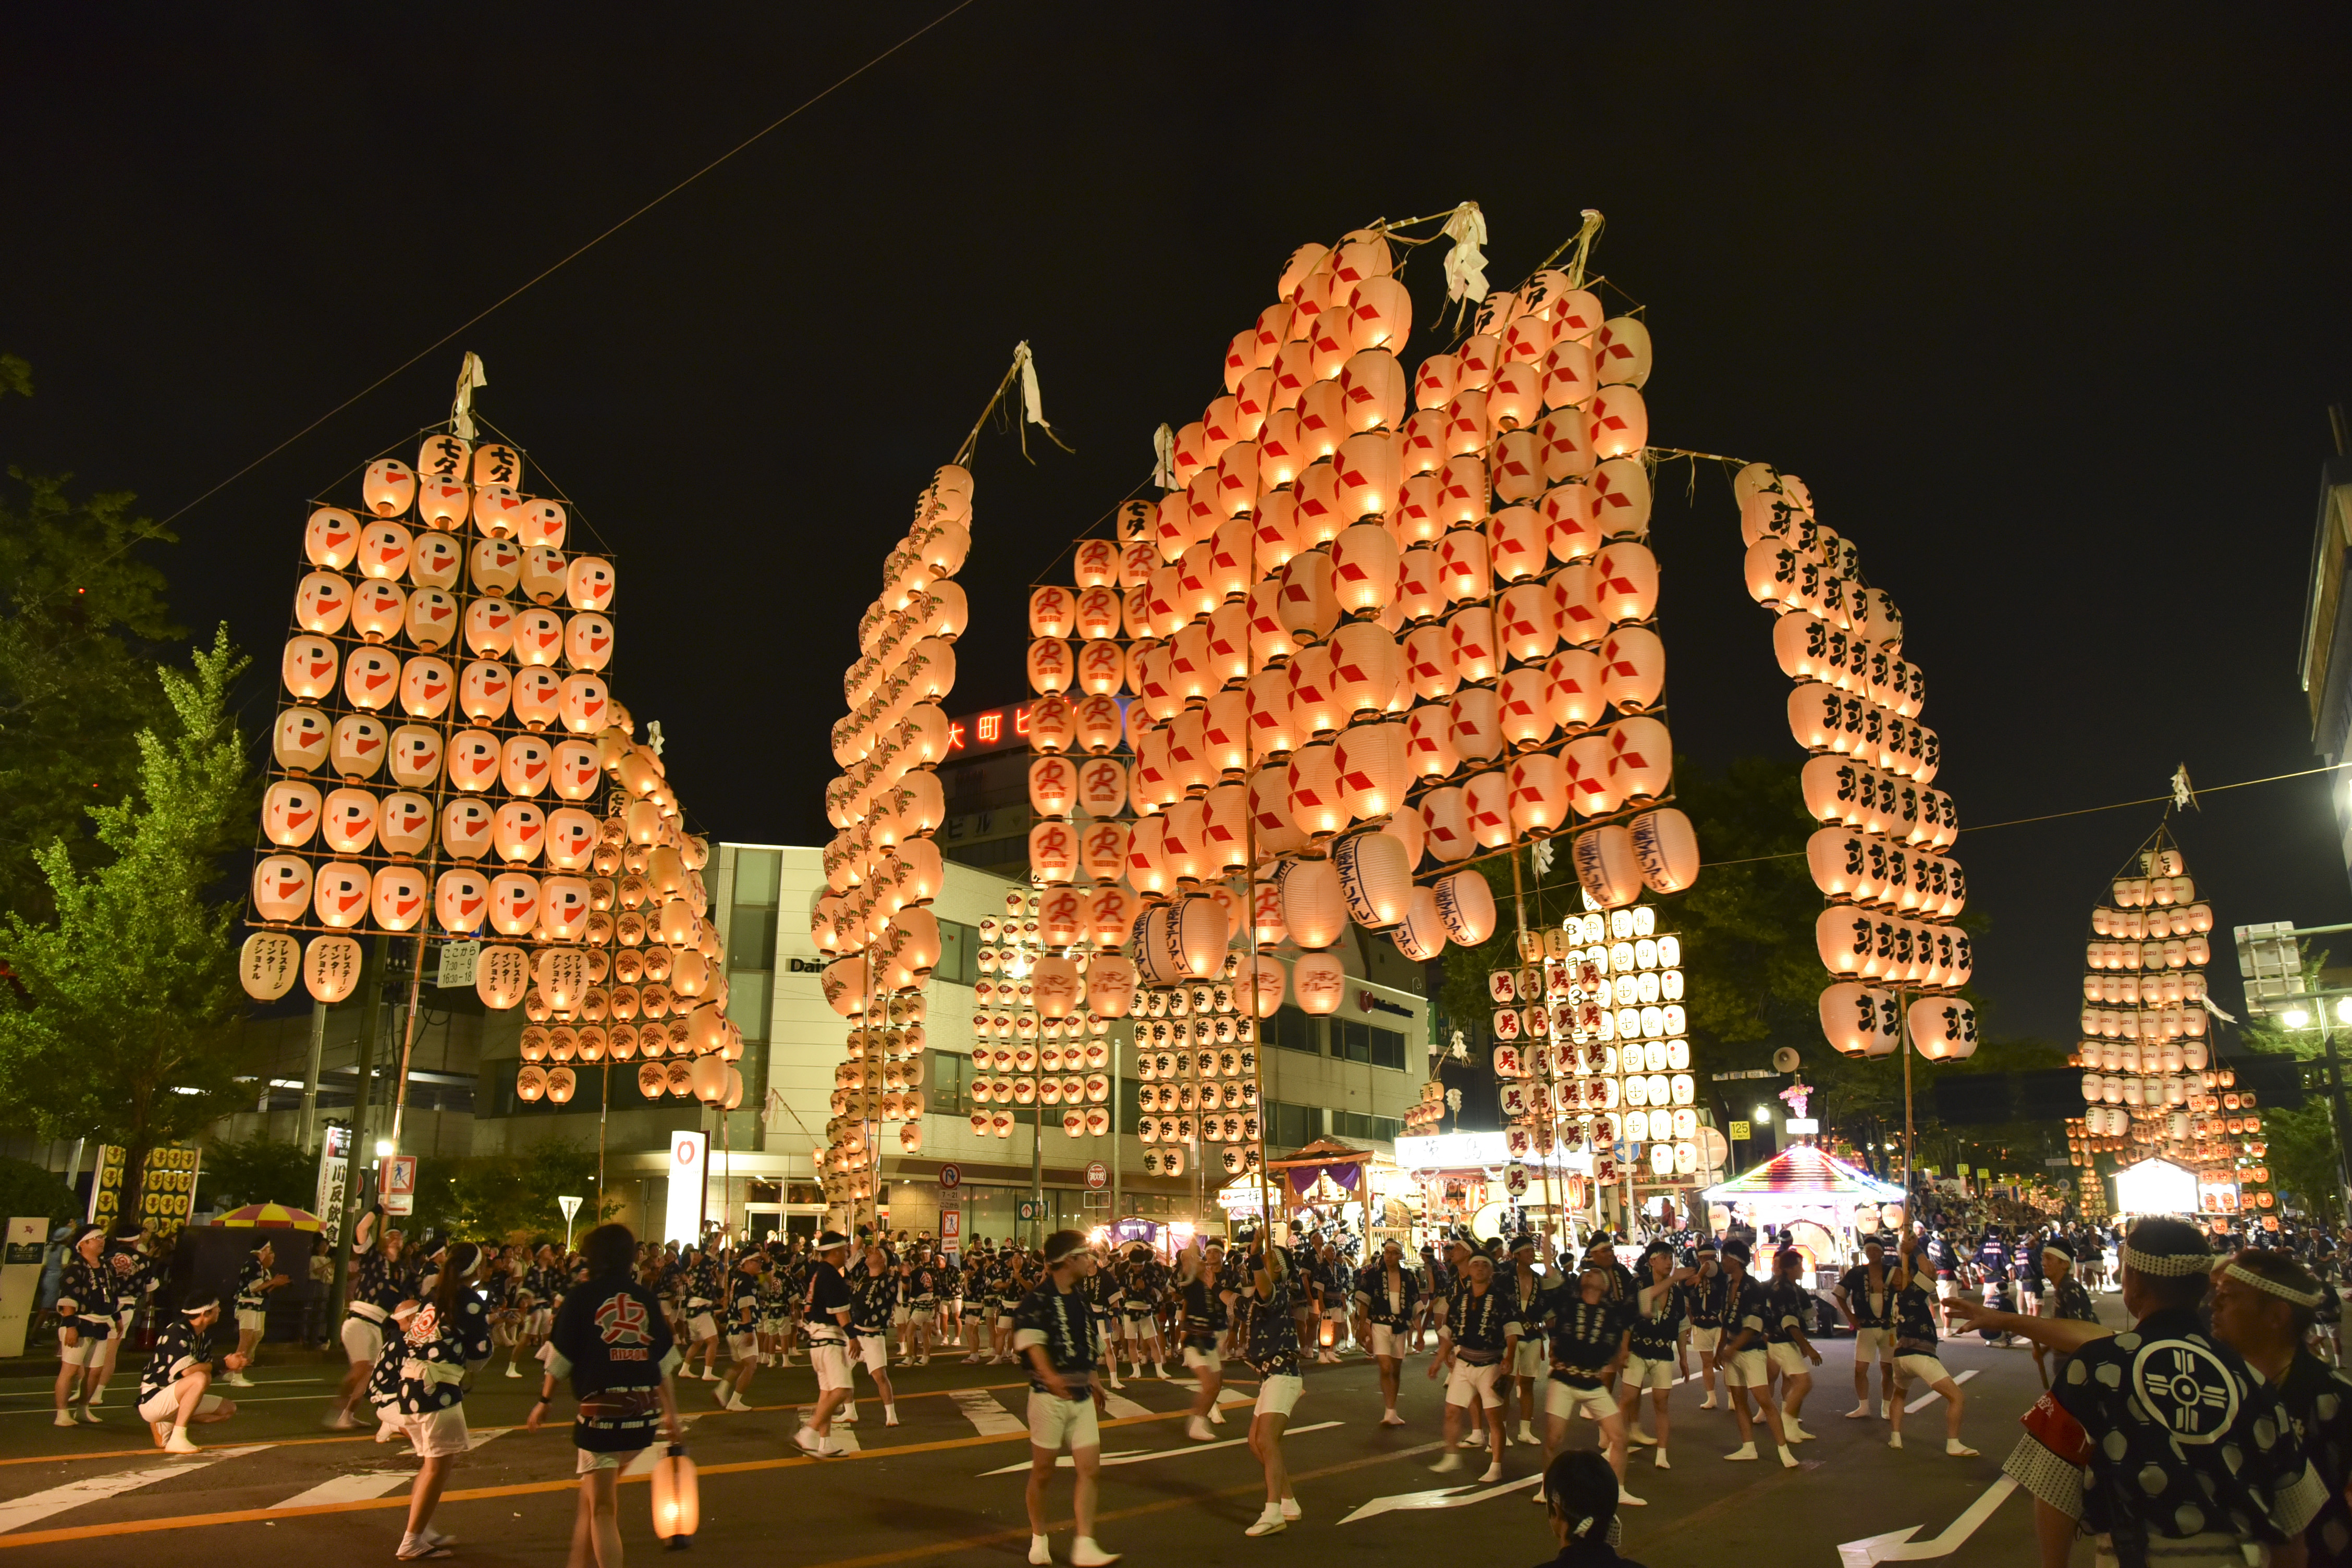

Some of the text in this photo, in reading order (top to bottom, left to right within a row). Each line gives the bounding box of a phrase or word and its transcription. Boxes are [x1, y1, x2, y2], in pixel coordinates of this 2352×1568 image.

[434, 438, 462, 474] 七夕
[488, 446, 514, 483] 七夕
[1126, 501, 1148, 538] 七夕
[2160, 856, 2171, 873] 七夕
[266, 939, 277, 972] インター
[330, 944, 340, 976] インター
[444, 946, 476, 958] ここから
[502, 953, 510, 984] インター
[564, 955, 572, 985] インター
[1732, 1123, 1748, 1134] 125
[1837, 1146, 1851, 1154] 123
[1089, 1171, 1105, 1181] 消火栓
